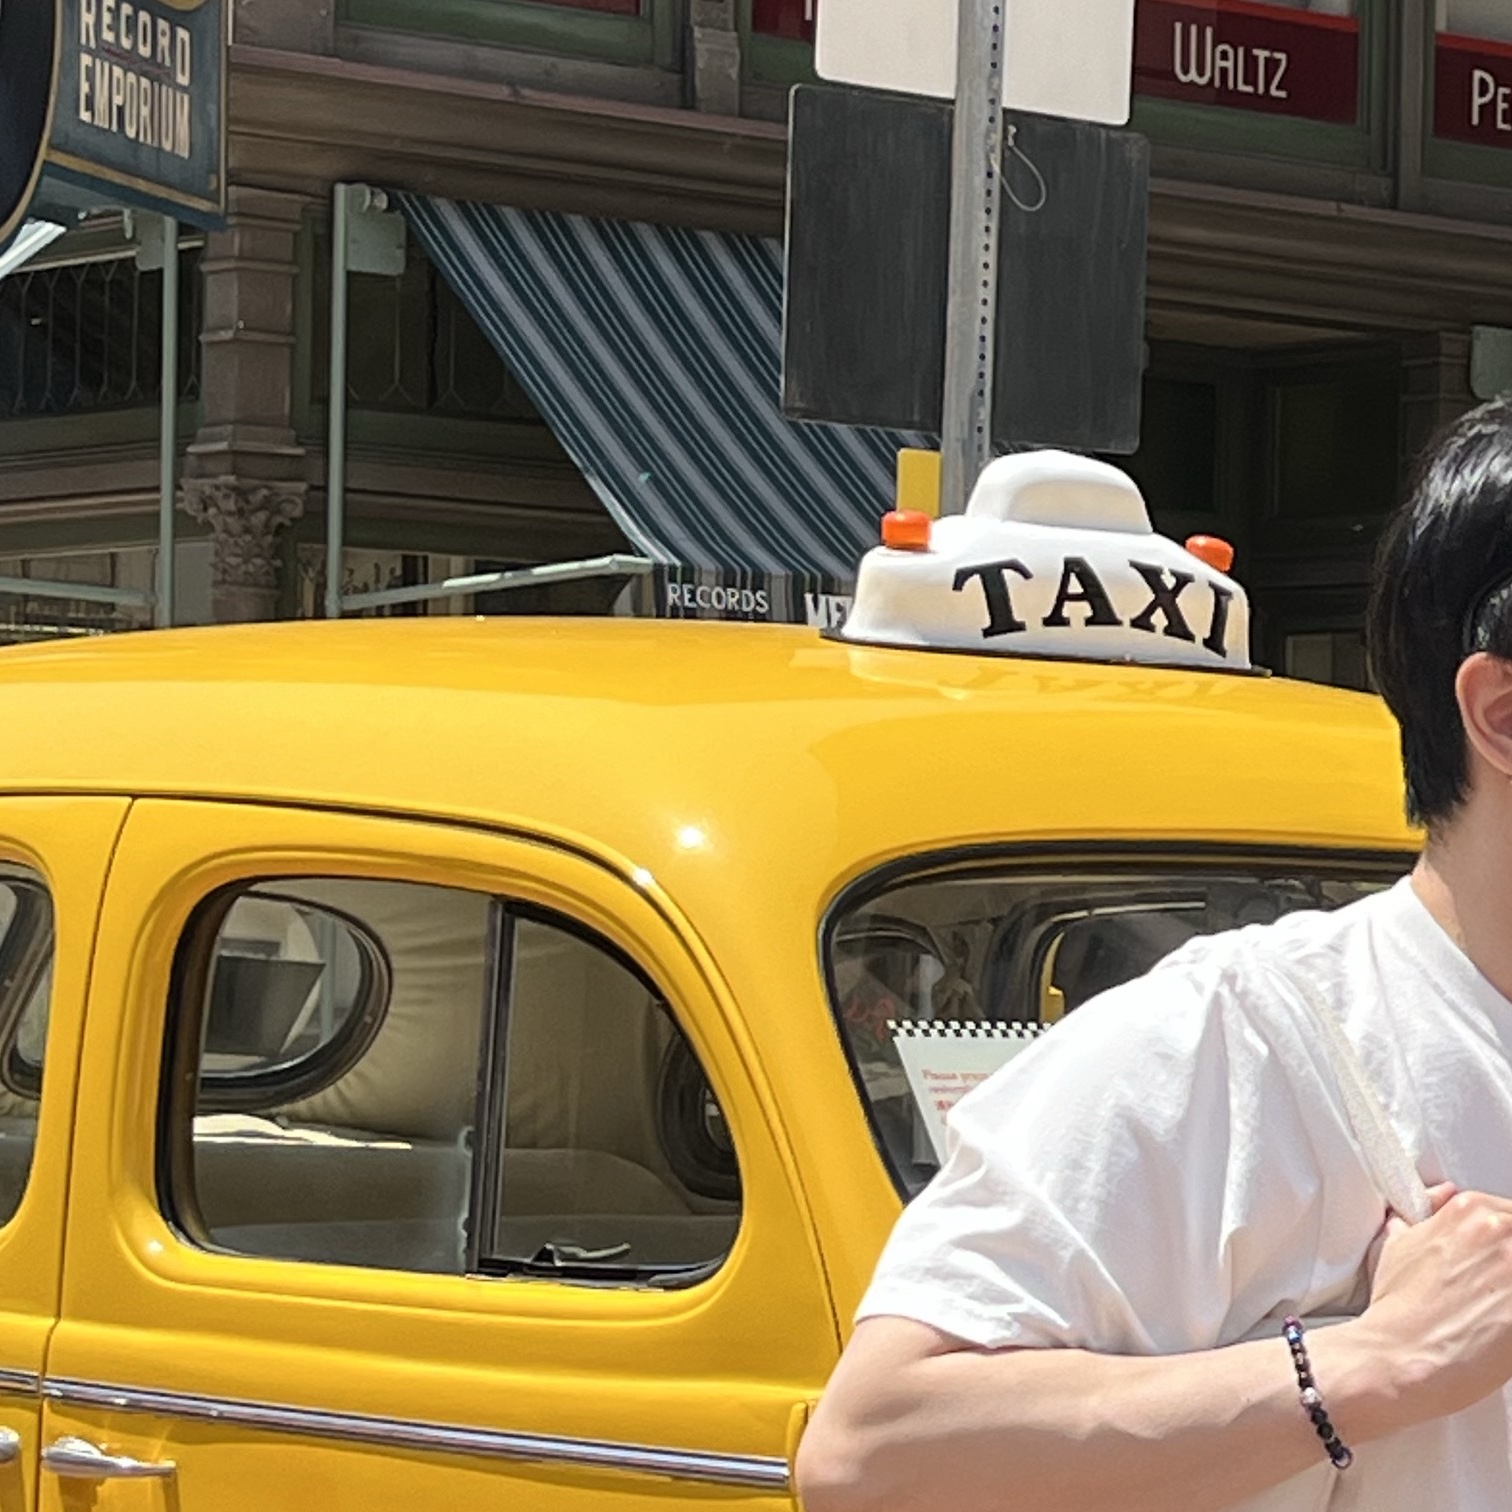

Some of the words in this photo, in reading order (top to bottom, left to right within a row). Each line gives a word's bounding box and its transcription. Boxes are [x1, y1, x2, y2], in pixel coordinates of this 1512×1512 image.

[80, 0, 190, 87] RECORD
[79, 52, 190, 160] EMPORIUM
[667, 583, 770, 614] RECORDS
[952, 556, 1234, 658] TAXI
